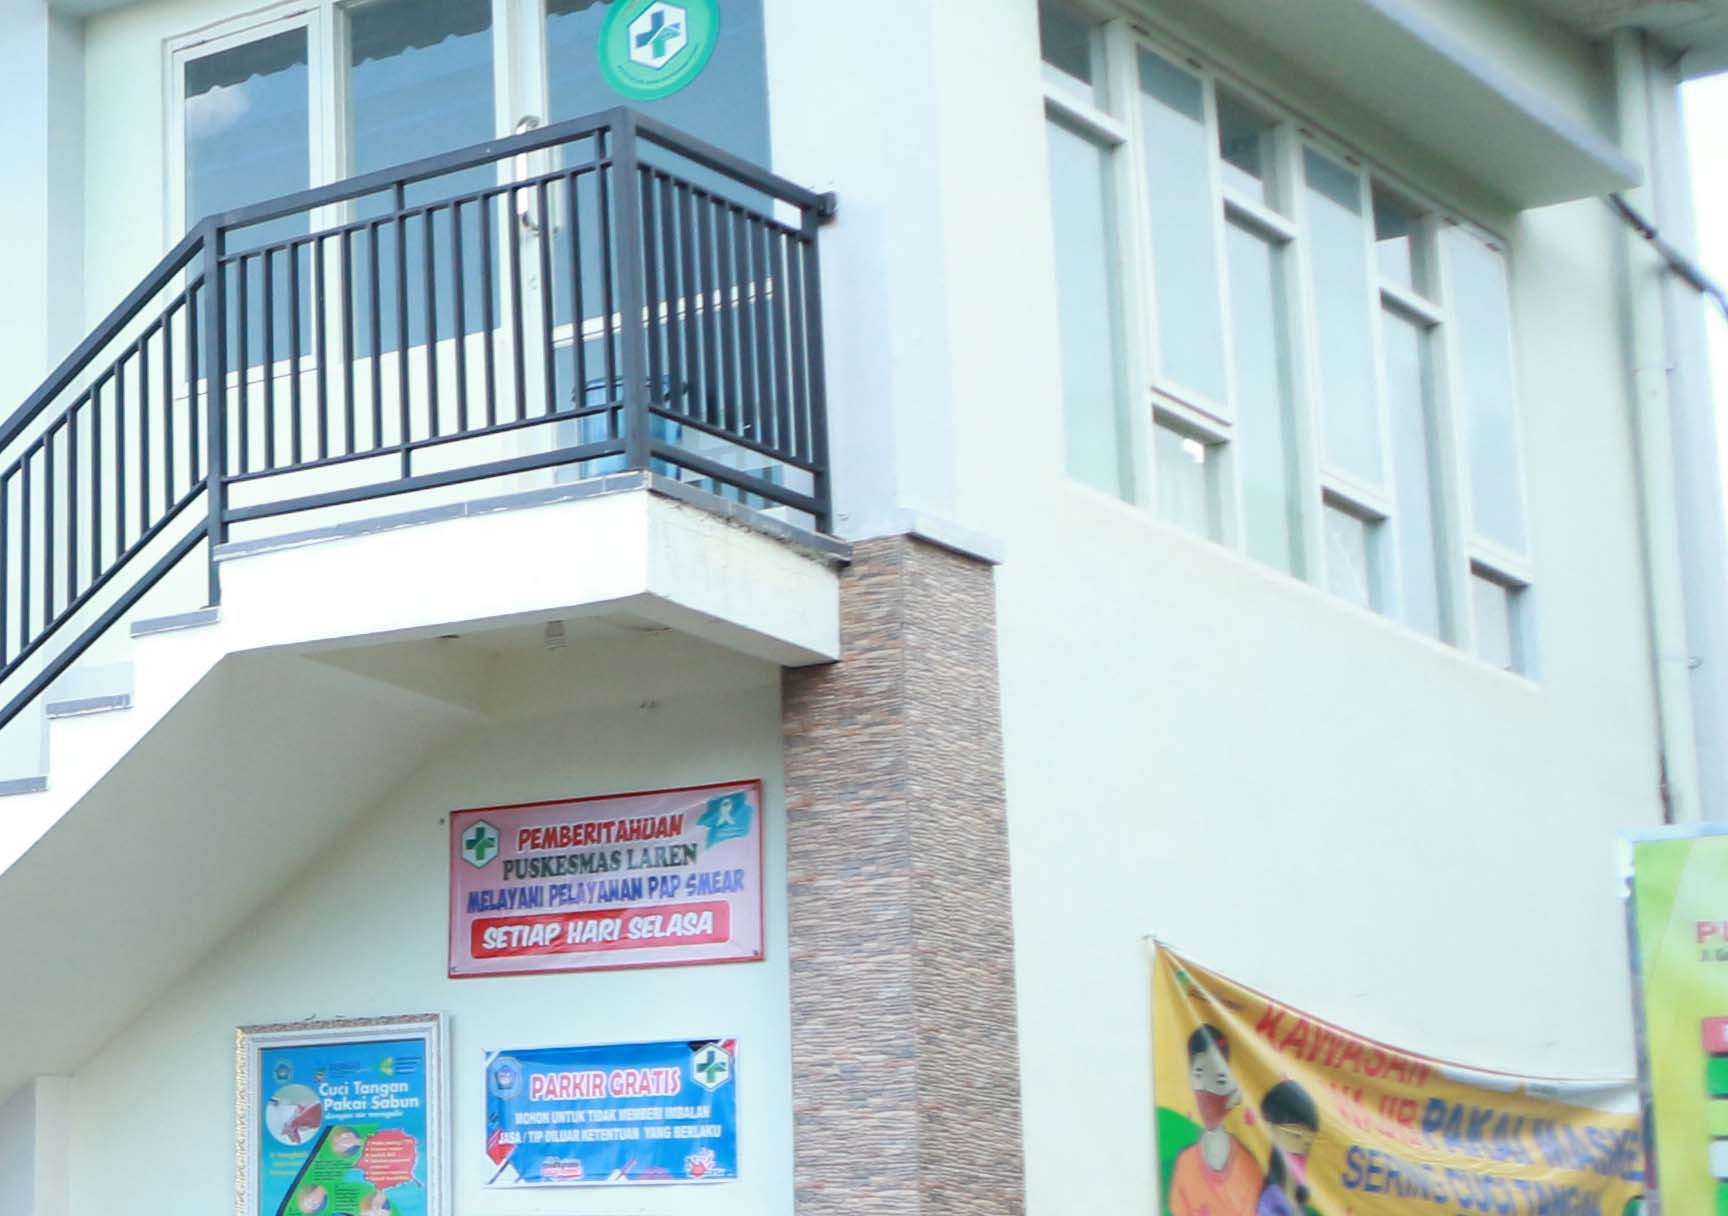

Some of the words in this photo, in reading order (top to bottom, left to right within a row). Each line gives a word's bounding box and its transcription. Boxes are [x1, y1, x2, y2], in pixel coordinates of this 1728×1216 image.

[517, 814, 684, 851] PEMBERITAHUAN
[502, 848, 622, 881] PUSKESMAS
[626, 843, 698, 871] LAREN
[466, 885, 545, 914] MELAYANI
[548, 877, 644, 908] PELAYANAN
[648, 874, 682, 899] PAP
[685, 868, 746, 897] SMEAR
[482, 921, 562, 950] SETIAP
[566, 918, 623, 944] HARI
[627, 910, 714, 940] SELASA
[319, 1082, 349, 1097] Cuci
[353, 1080, 409, 1098] Tangan
[531, 1073, 606, 1100] PARKIR
[608, 1067, 681, 1097] GRATIS
[323, 1096, 367, 1112] Pakai
[371, 1095, 420, 1111] Sabun
[551, 1110, 586, 1124] UNTUK
